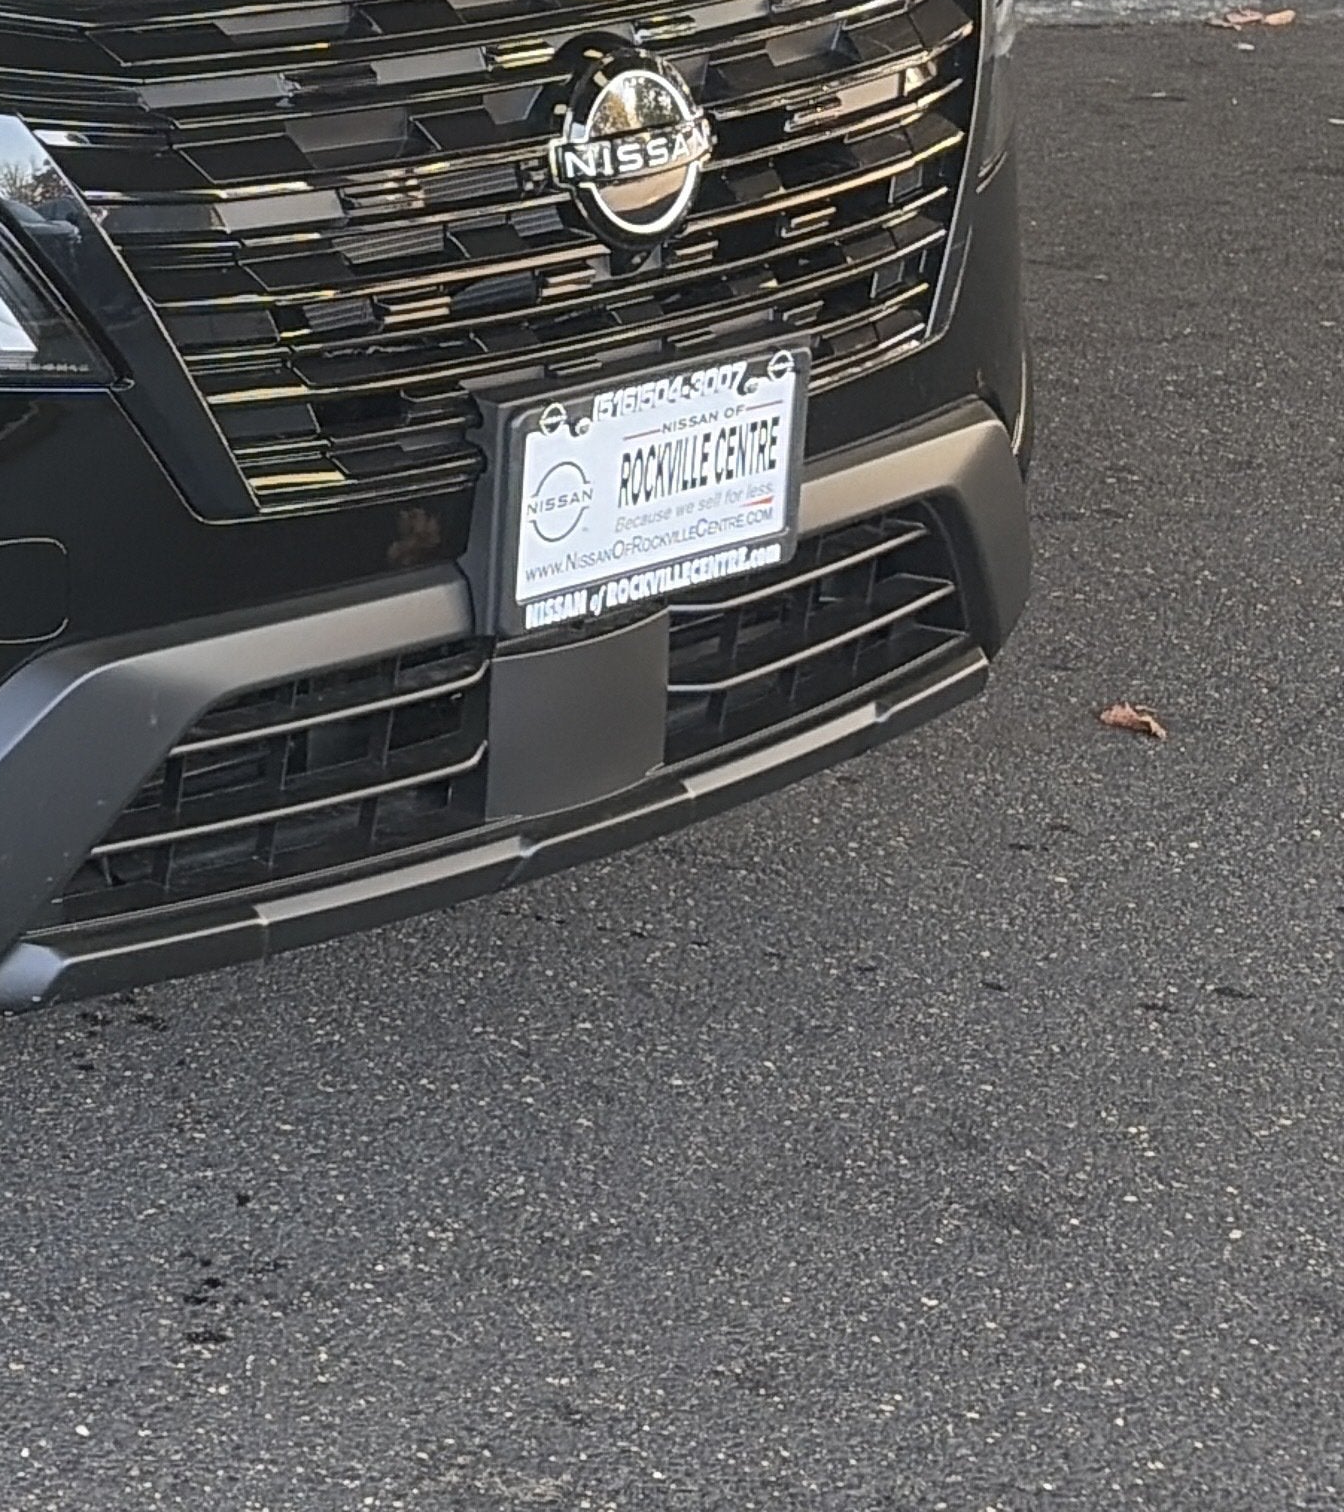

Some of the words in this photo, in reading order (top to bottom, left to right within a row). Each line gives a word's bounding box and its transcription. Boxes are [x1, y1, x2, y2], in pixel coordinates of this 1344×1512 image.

[563, 127, 711, 178] NISSAN
[662, 410, 719, 434] NISSAN
[723, 404, 746, 420] OF
[617, 432, 712, 509] ROCKVILLE
[714, 416, 781, 485] CENTRE
[526, 487, 594, 516] NISSAN
[615, 507, 673, 534] Because
[675, 502, 695, 518] we
[525, 588, 588, 630] NISSAN
